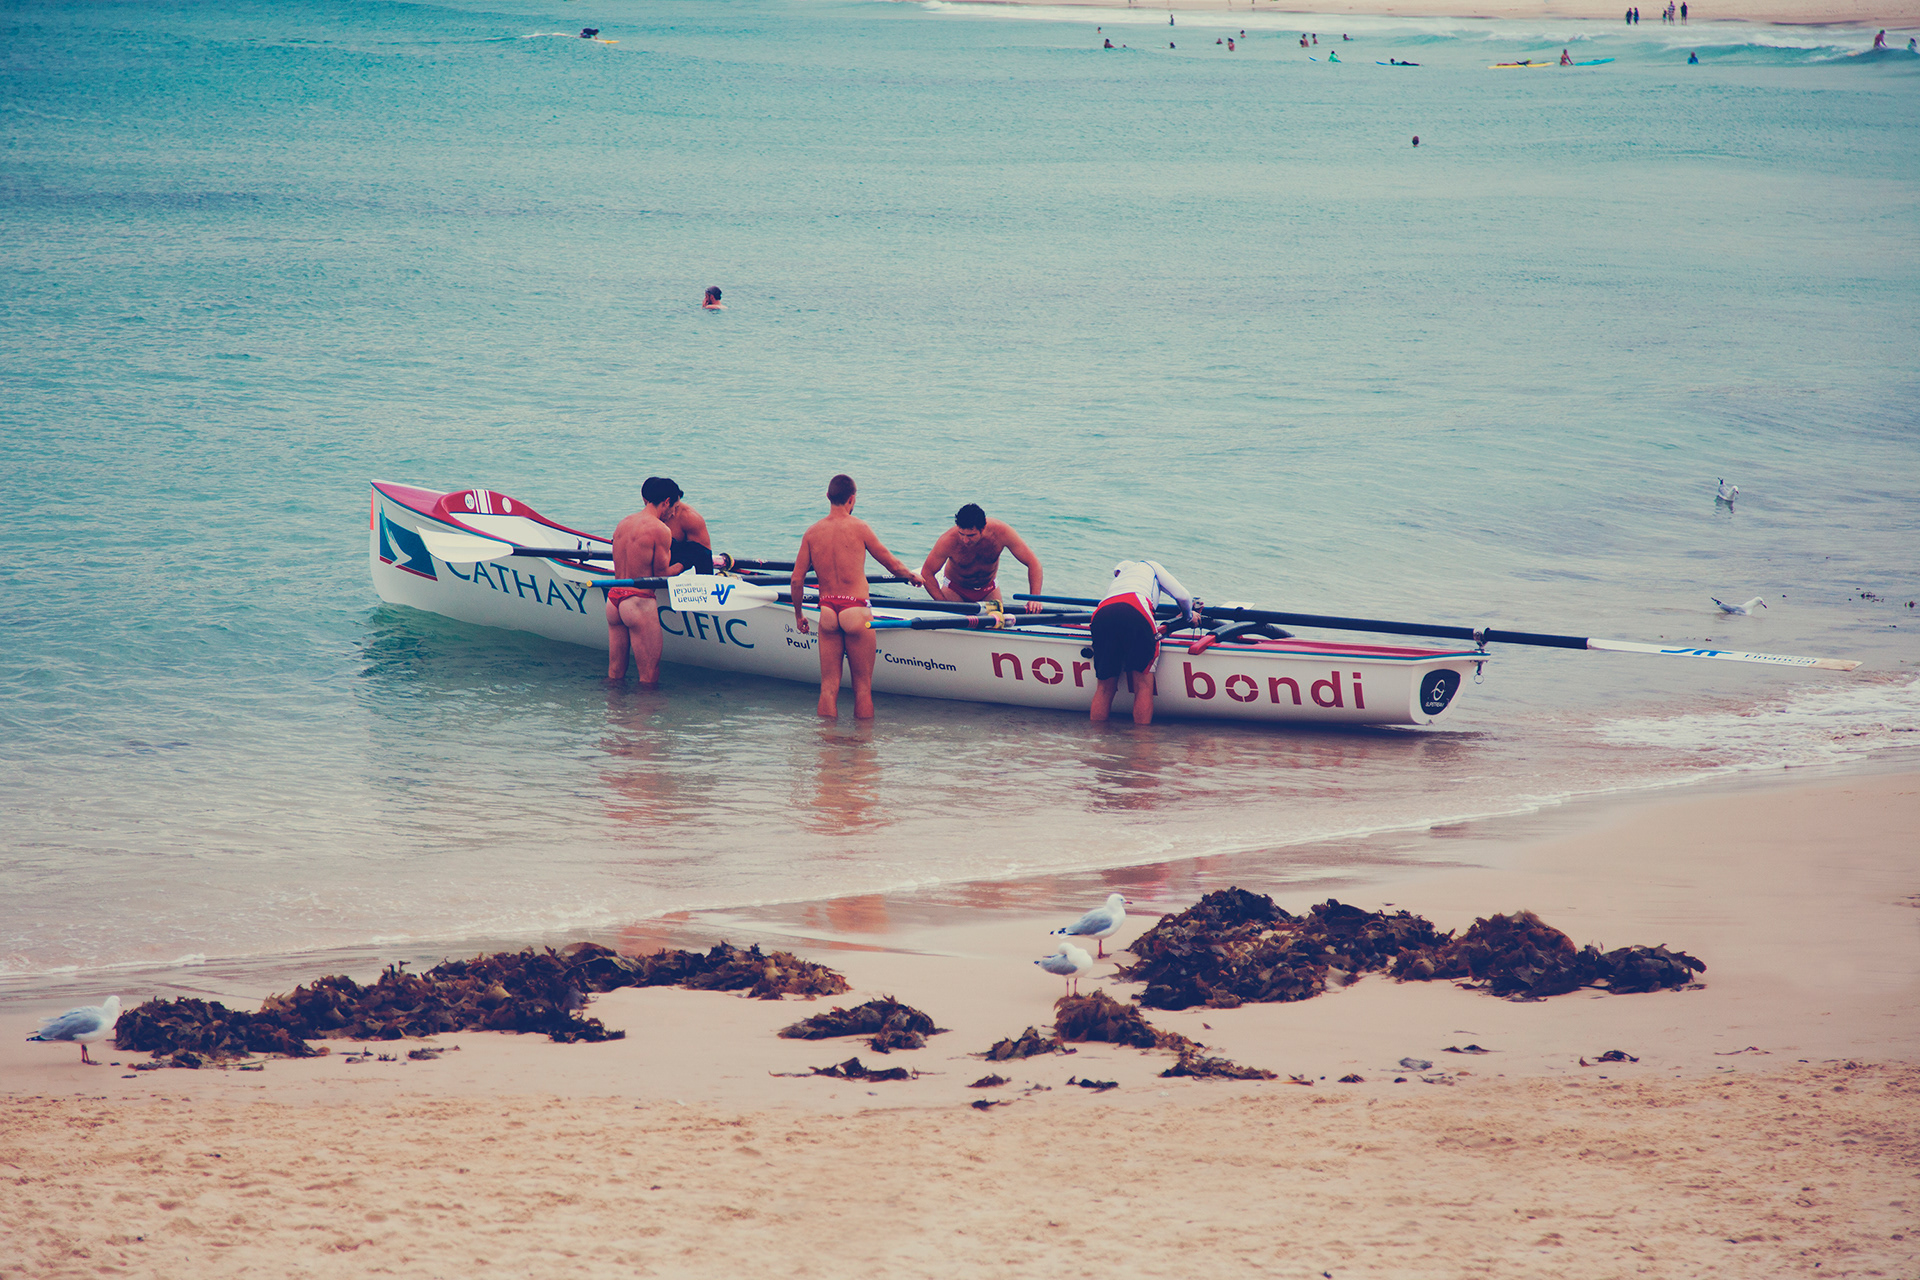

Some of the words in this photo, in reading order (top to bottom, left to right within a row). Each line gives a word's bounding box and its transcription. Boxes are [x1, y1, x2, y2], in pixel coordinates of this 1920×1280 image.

[674, 587, 707, 597] Financial
[678, 596, 707, 604] Ashman
[445, 561, 587, 615] CATHAY
[601, 586, 755, 649] CIFIC
[884, 653, 957, 671] Cunningham
[991, 652, 1158, 696] nor
[1183, 661, 1365, 709] bondi
